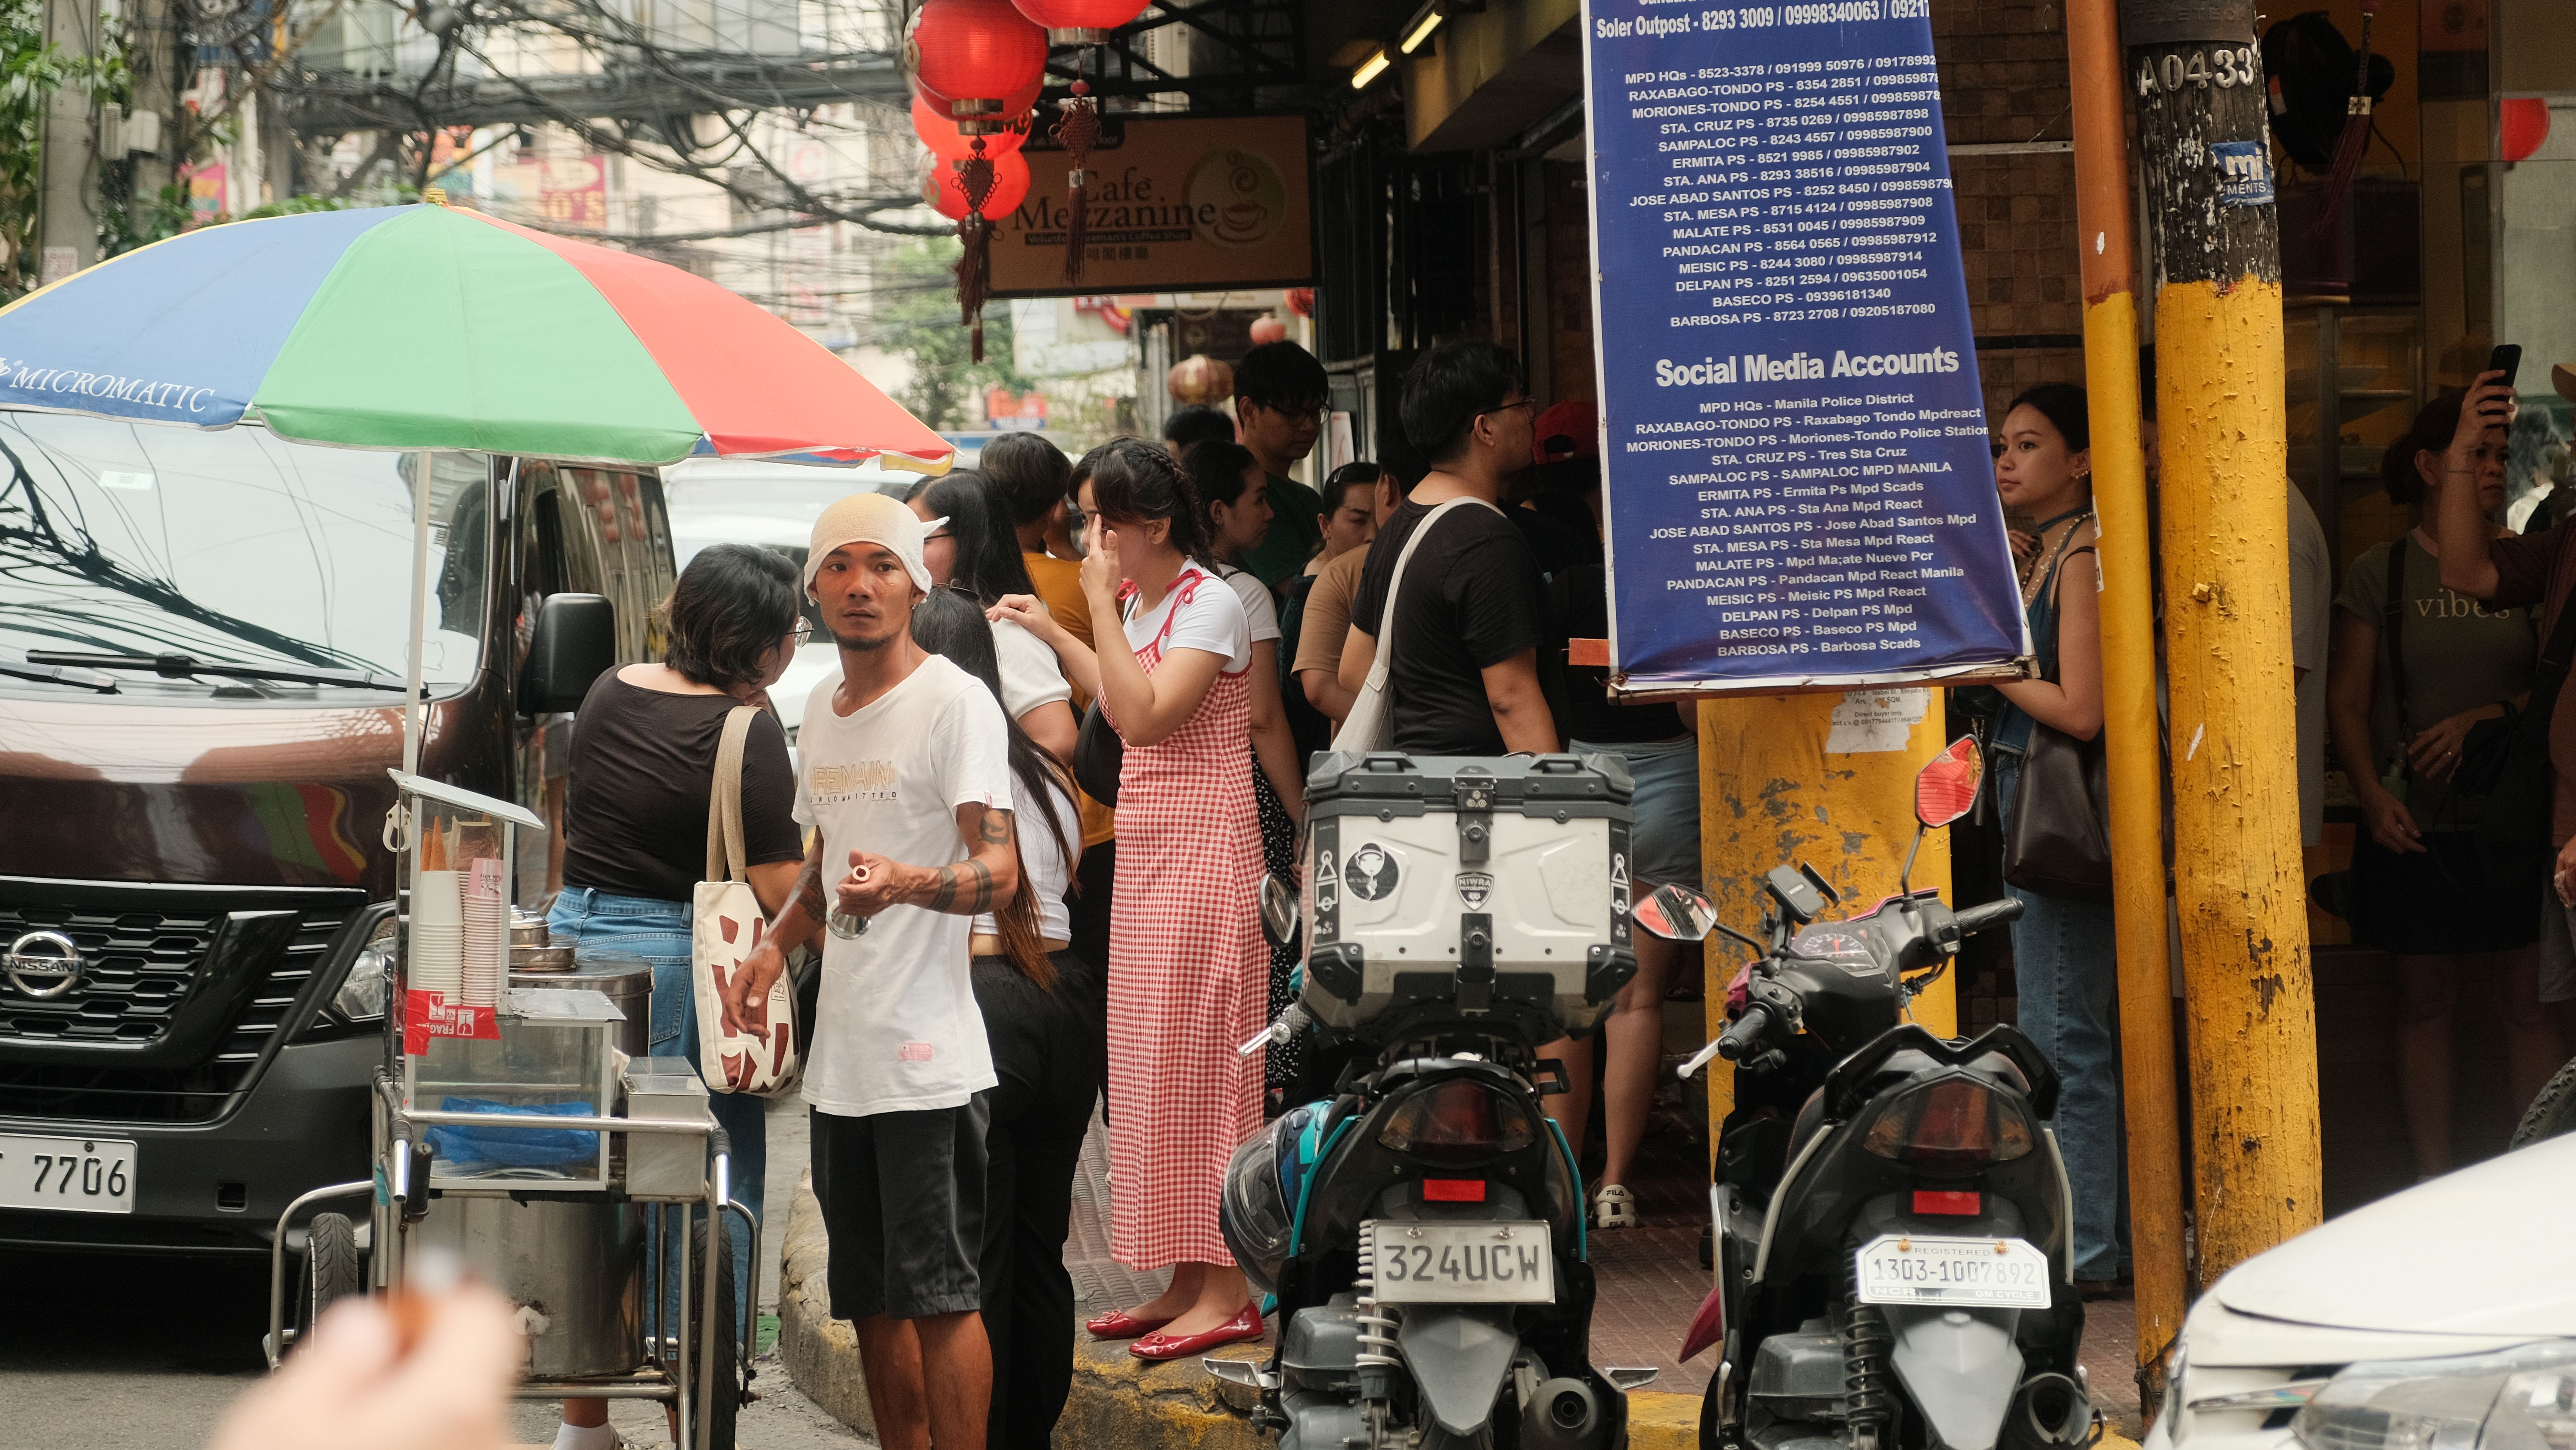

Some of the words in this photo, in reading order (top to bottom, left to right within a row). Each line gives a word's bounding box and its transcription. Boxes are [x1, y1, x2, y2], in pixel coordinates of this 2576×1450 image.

[1597, 18, 1633, 38] Soler
[1636, 13, 1690, 38] Outpost
[1702, 9, 1736, 31] 8293
[1739, 7, 1774, 28] 3009
[1785, 0, 1880, 25] 09998340063
[1625, 72, 1655, 84] MPD
[1659, 71, 1687, 81] HQs
[1698, 65, 1764, 79] 8523-3378
[1776, 62, 1822, 74] 091999
[1826, 59, 1865, 71] 50976
[2138, 47, 2254, 96] A0433
[1661, 123, 1690, 134] STA.
[1694, 120, 1733, 132] CRUZ
[1736, 118, 1755, 129] PS
[1766, 116, 1798, 128] 8735
[1801, 114, 1832, 126] 0269
[1843, 108, 1929, 123] 09985987898
[1659, 137, 1736, 152] SAMPALOC
[1740, 136, 1758, 147] PS
[1770, 134, 1801, 145] 8243
[1804, 132, 1835, 142] 4557
[1847, 126, 1932, 140] 09985987900
[1664, 175, 1694, 187] STA.
[1697, 173, 1727, 185] ANA
[1730, 172, 1748, 182] PS
[1760, 170, 1791, 181] 8293
[1795, 167, 1834, 179] 38516
[1844, 162, 1930, 176] 09985987904
[1013, 196, 1215, 230] Mezanine
[1673, 226, 1729, 239] MALATE
[1733, 225, 1752, 235] PS
[1763, 223, 1792, 234] 8531
[1797, 220, 1829, 232] 0045
[1840, 215, 1925, 229] 09985987909
[1663, 243, 1740, 257] PANDACAN
[1745, 242, 1763, 252] PS
[1775, 239, 1806, 251] 8564
[1809, 237, 1840, 249] 0565
[1852, 232, 1937, 246] 09985987912
[1713, 294, 1772, 307] BASECO
[1776, 293, 1794, 303] PS
[1806, 288, 1891, 302] 09396181340
[1671, 314, 1740, 327] BARBOSA
[1743, 313, 1762, 323] PS
[1773, 310, 1804, 322] 8723
[1808, 308, 1839, 320] 2708
[1850, 303, 1935, 317] 09205187080
[1656, 356, 1737, 387] Social
[1744, 352, 1825, 382] Media
[1831, 346, 1959, 378] Accounts
[9, 367, 215, 412] MICROMATIC
[1700, 402, 1731, 413] MPD
[1734, 401, 1763, 411] HQs
[1775, 398, 1818, 409] Manila
[1822, 396, 1862, 407] Police
[1866, 393, 1914, 405] District
[1636, 418, 1770, 434] RAXABAGO-TONDO
[1773, 417, 1792, 427] PS
[1804, 414, 1870, 426] Raxabago
[1873, 411, 1915, 422] Tondo
[1919, 408, 1981, 422] Mpdreact
[1627, 436, 1755, 452] MORIONES-TONDO
[1759, 435, 1777, 445] PS
[1789, 429, 1897, 444] Moriones-Tondo
[1900, 428, 1941, 438] Police
[1945, 425, 1989, 436] Station
[1712, 455, 1742, 465] STA.
[1746, 452, 1785, 464] CRUZ
[1788, 451, 1807, 462] PS
[1818, 450, 1847, 460] Tres
[1850, 448, 1872, 459] Sta
[1875, 447, 1907, 457] Cruz
[1669, 471, 1747, 485] SAMPALOC
[1751, 471, 1769, 481] PS
[1781, 466, 1859, 479] SAMPALOC
[1863, 464, 1894, 476] MPD
[1898, 462, 1952, 474] MANILA
[1693, 543, 1724, 554] STA.
[1727, 541, 1768, 552] MESA
[1771, 540, 1789, 550] PS
[1801, 539, 1822, 549] Sta
[1826, 538, 1860, 547] Mesa
[1865, 535, 1892, 547] Mpd
[1896, 533, 1934, 544] React
[1696, 559, 1752, 571] MALATE
[1756, 558, 1775, 568] PS
[1786, 556, 1815, 569] Mpd
[1819, 555, 1862, 566] Ma;ate
[1866, 554, 1907, 563] Nueve
[1911, 551, 1934, 561] Pcr
[1667, 577, 1745, 590] PANDACAN
[1749, 576, 1767, 586] PS
[1779, 573, 1844, 584] Pandacan
[1848, 571, 1876, 583] Mpd
[1880, 570, 1918, 580] React
[1921, 567, 1964, 578] Manila
[1722, 610, 1778, 622] DELPAN
[1782, 609, 1800, 619] PS
[1812, 607, 1858, 619] Delpan
[1862, 605, 1880, 615] PS
[1884, 604, 1912, 616] Mpd
[1720, 627, 1779, 640] BASECO
[1783, 626, 1801, 636] PS
[1813, 625, 1862, 635] Baseco
[1866, 622, 1885, 633] PS
[1888, 621, 1917, 633] Mpd
[1718, 644, 1788, 656] BARBOSA
[1790, 643, 1809, 654] PS
[1821, 642, 1876, 652] Barbosa
[1880, 638, 1921, 649] Scads
[813, 761, 892, 795] REMAIN
[1459, 878, 1491, 886] NIWRA
[9, 959, 74, 972] NISSAN
[34, 1155, 127, 1196] 7706
[1385, 1245, 1539, 1282] 324UCW
[1914, 1247, 1991, 1257] REGISTERED
[1874, 1258, 2037, 1286] 1303-1007892
[1875, 1287, 1916, 1296] NCR
